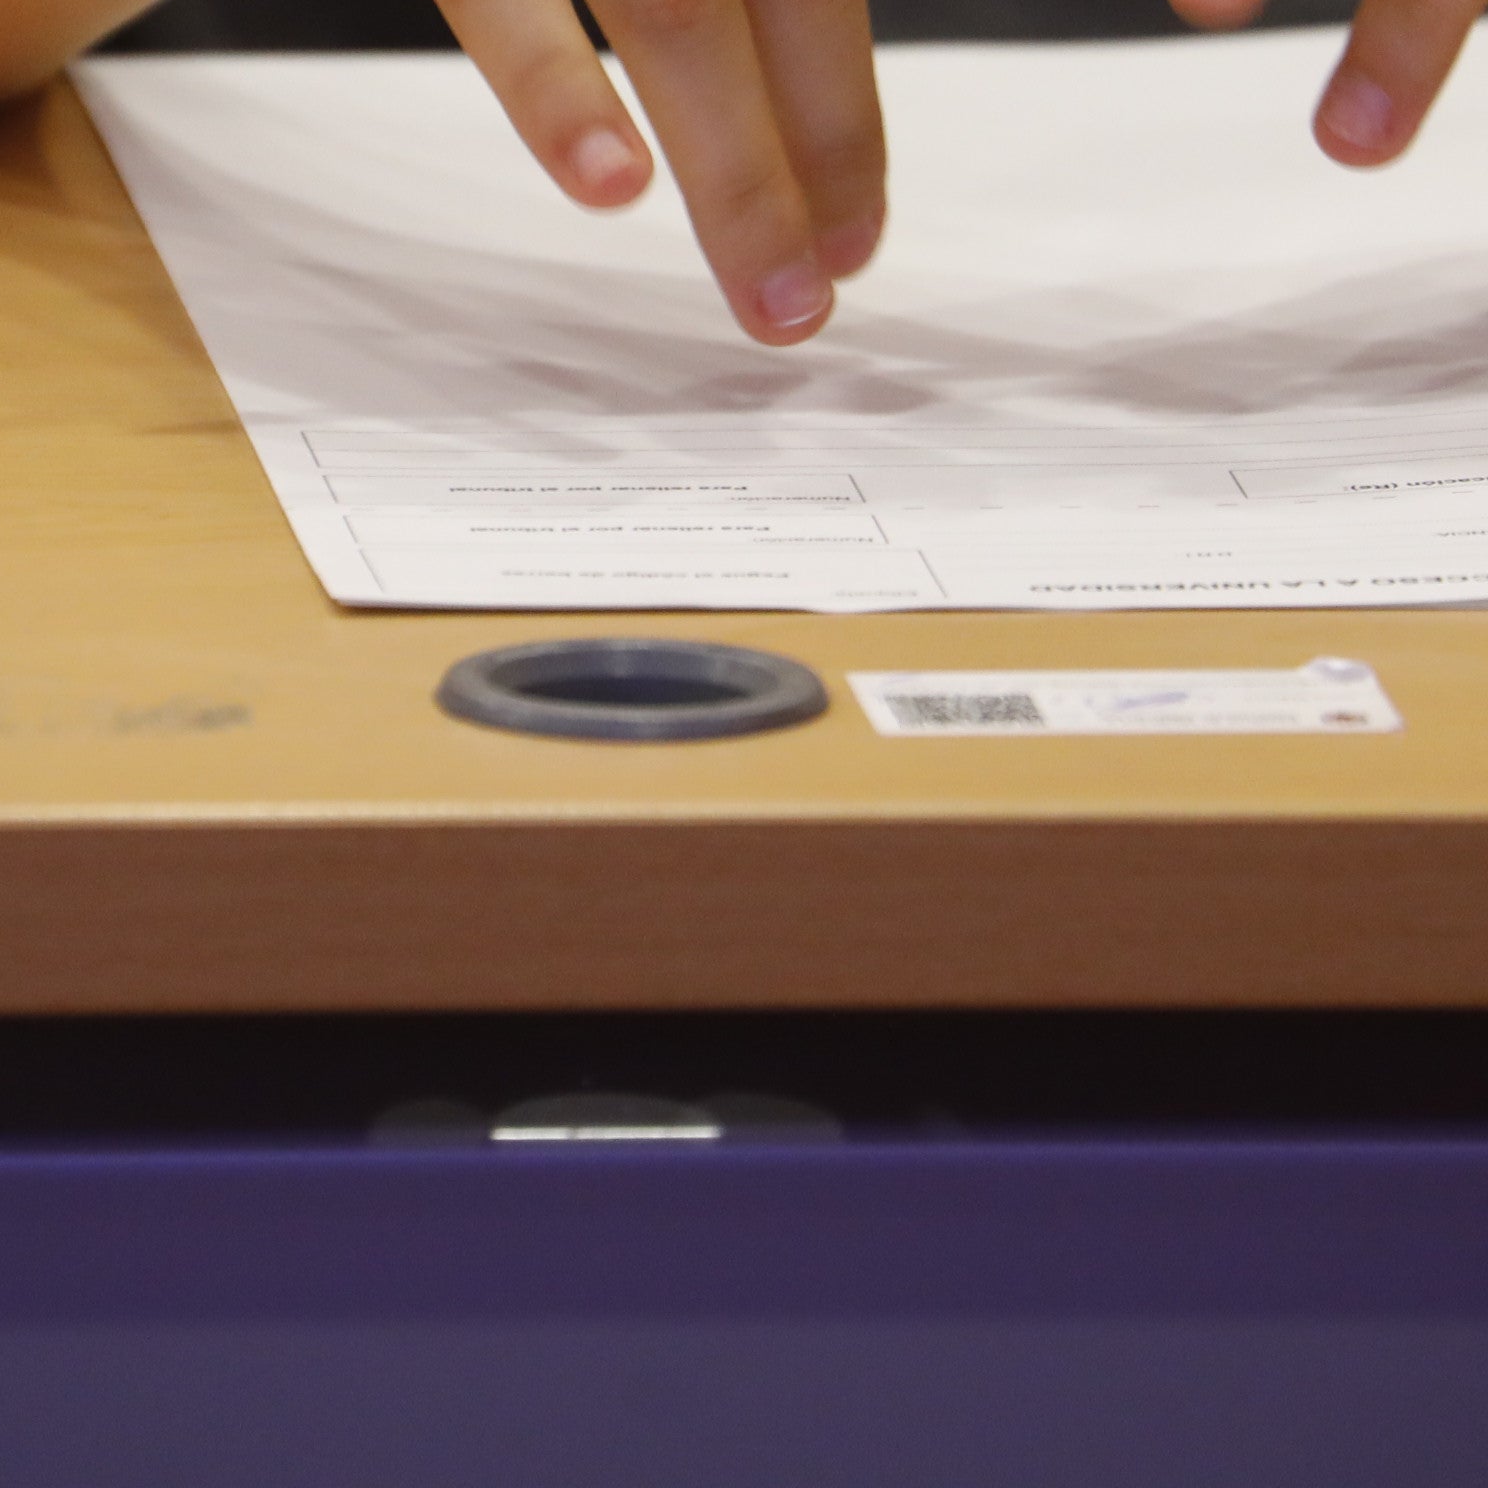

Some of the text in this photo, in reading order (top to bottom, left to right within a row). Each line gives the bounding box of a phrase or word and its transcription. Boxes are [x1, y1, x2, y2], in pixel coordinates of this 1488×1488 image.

[447, 485, 532, 493] tribunal
[609, 484, 690, 492] rellenar
[697, 484, 747, 492] Para
[719, 524, 769, 532] Para
[1028, 580, 1270, 592] UNIVERSIDAD
[1280, 578, 1325, 588] LA
[1335, 578, 1358, 587] A
